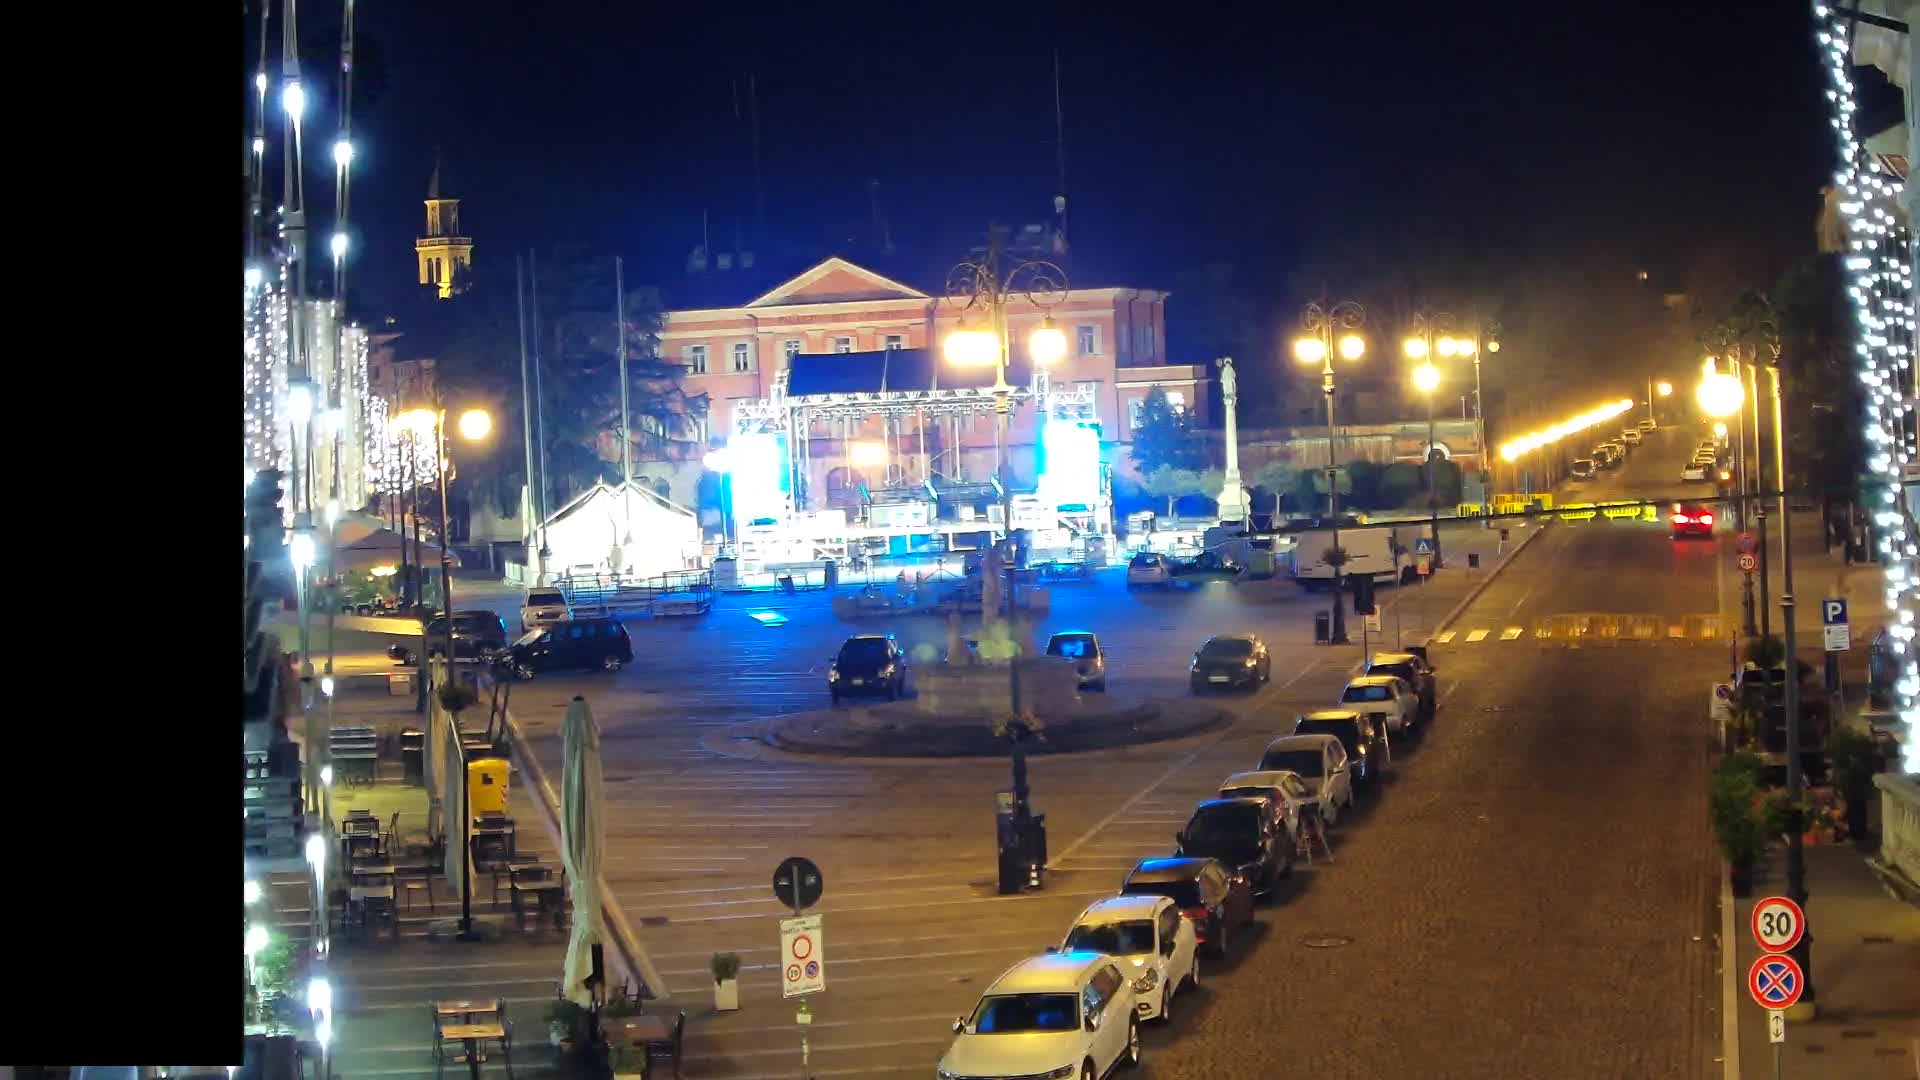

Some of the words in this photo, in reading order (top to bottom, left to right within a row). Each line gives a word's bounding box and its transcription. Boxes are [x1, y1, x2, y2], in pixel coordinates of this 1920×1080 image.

[1742, 558, 1753, 567] 20
[1827, 602, 1842, 622] P
[1763, 912, 1791, 937] 30
